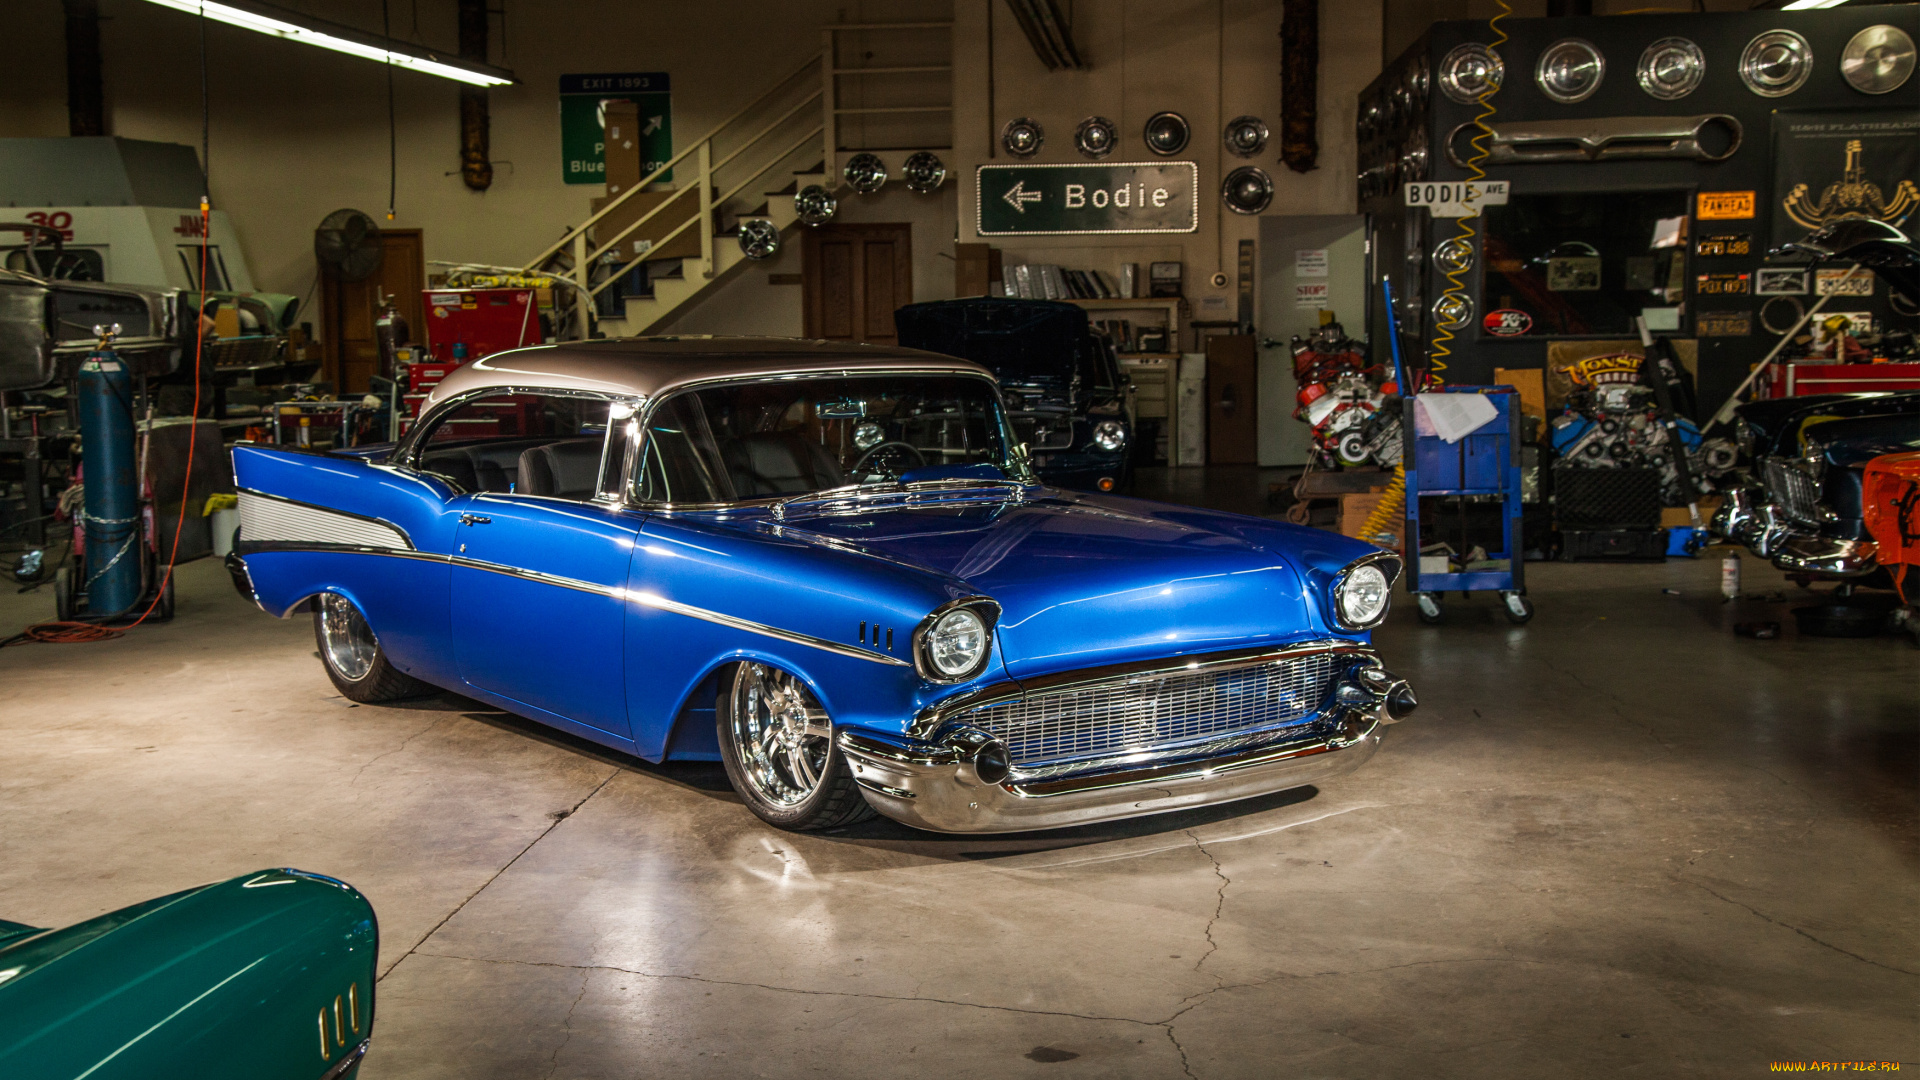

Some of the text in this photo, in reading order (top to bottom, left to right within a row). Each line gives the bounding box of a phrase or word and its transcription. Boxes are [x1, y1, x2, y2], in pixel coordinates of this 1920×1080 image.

[582, 78, 650, 89] EXIT 1893
[1065, 183, 1169, 209] Bodie
[1410, 185, 1474, 203] BODIE
[1703, 200, 1750, 212] PANHEAD
